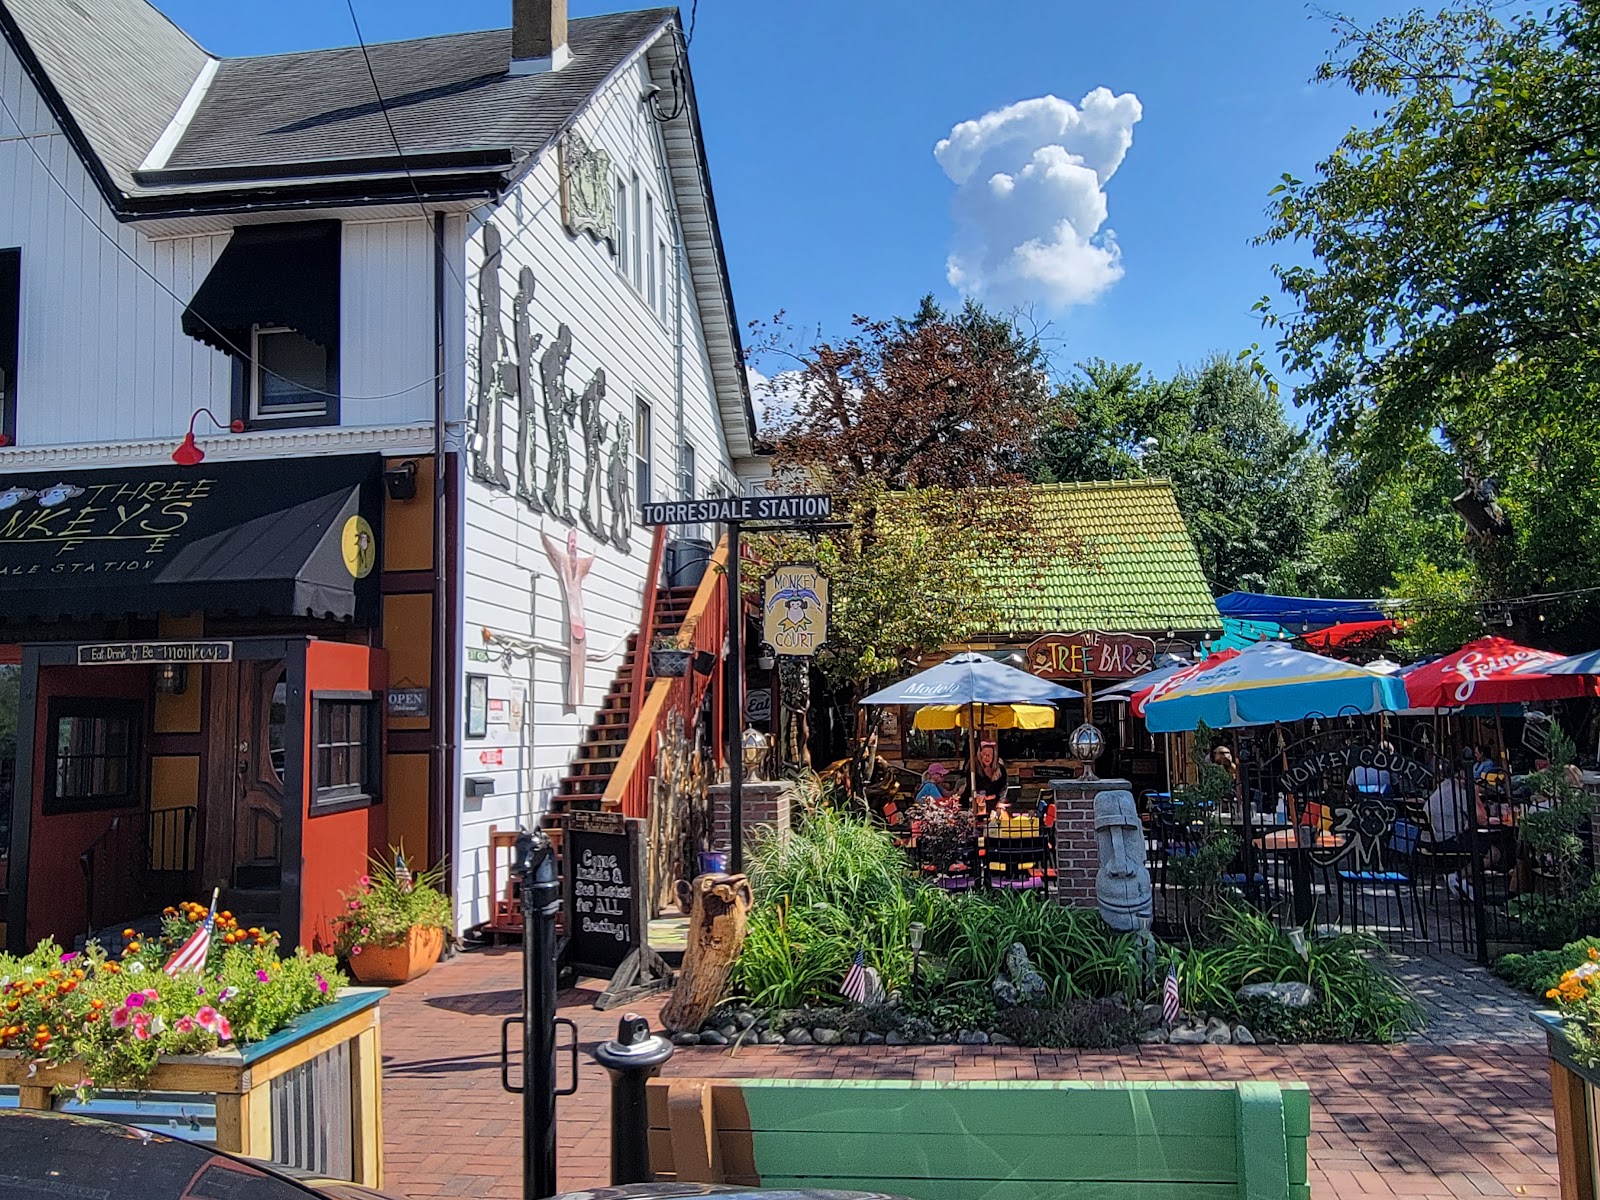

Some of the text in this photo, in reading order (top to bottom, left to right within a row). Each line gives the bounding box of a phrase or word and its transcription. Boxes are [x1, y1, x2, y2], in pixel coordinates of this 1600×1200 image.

[87, 479, 218, 504] THREE
[643, 497, 830, 524] TORRESDALE STATION
[50, 560, 155, 573] STATION
[774, 573, 819, 590] MONKEY
[775, 632, 816, 648] COURT
[1080, 633, 1102, 647] THE
[142, 646, 154, 659] Be
[1046, 642, 1136, 675] TREE BAR
[904, 682, 961, 696] Modelo
[388, 693, 423, 705] OPEN
[747, 697, 770, 712] Eat
[1280, 748, 1434, 792] MONKEY COURT
[582, 848, 618, 869] Come
[575, 880, 595, 896] See
[576, 897, 624, 915] for ALL
